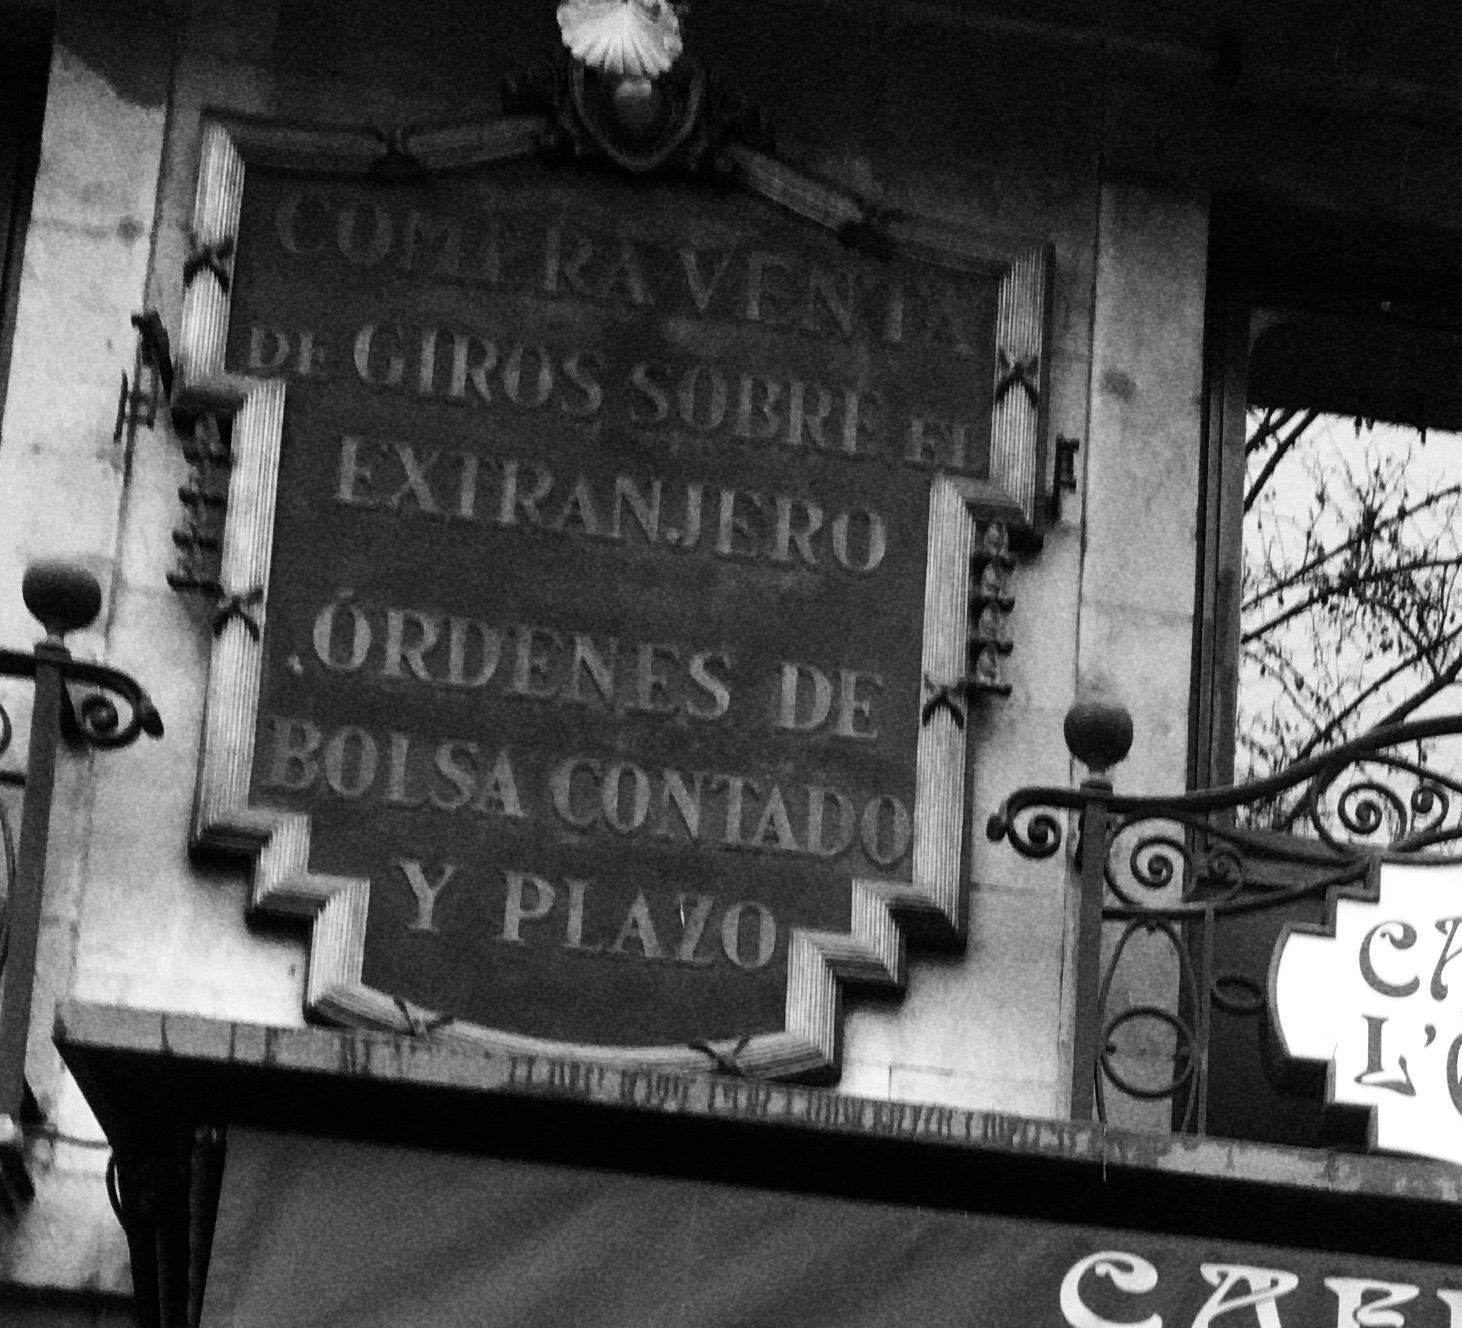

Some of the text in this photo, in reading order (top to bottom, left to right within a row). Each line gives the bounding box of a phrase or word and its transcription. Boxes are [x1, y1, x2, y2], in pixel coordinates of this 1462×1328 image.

[247, 322, 976, 470] DE GIROS SOBRE EL
[335, 435, 888, 573] EXTRANJERO
[776, 661, 885, 740] DE
[262, 713, 911, 866] BOLSA CONTADO
[397, 858, 778, 971] Y PLAZO
